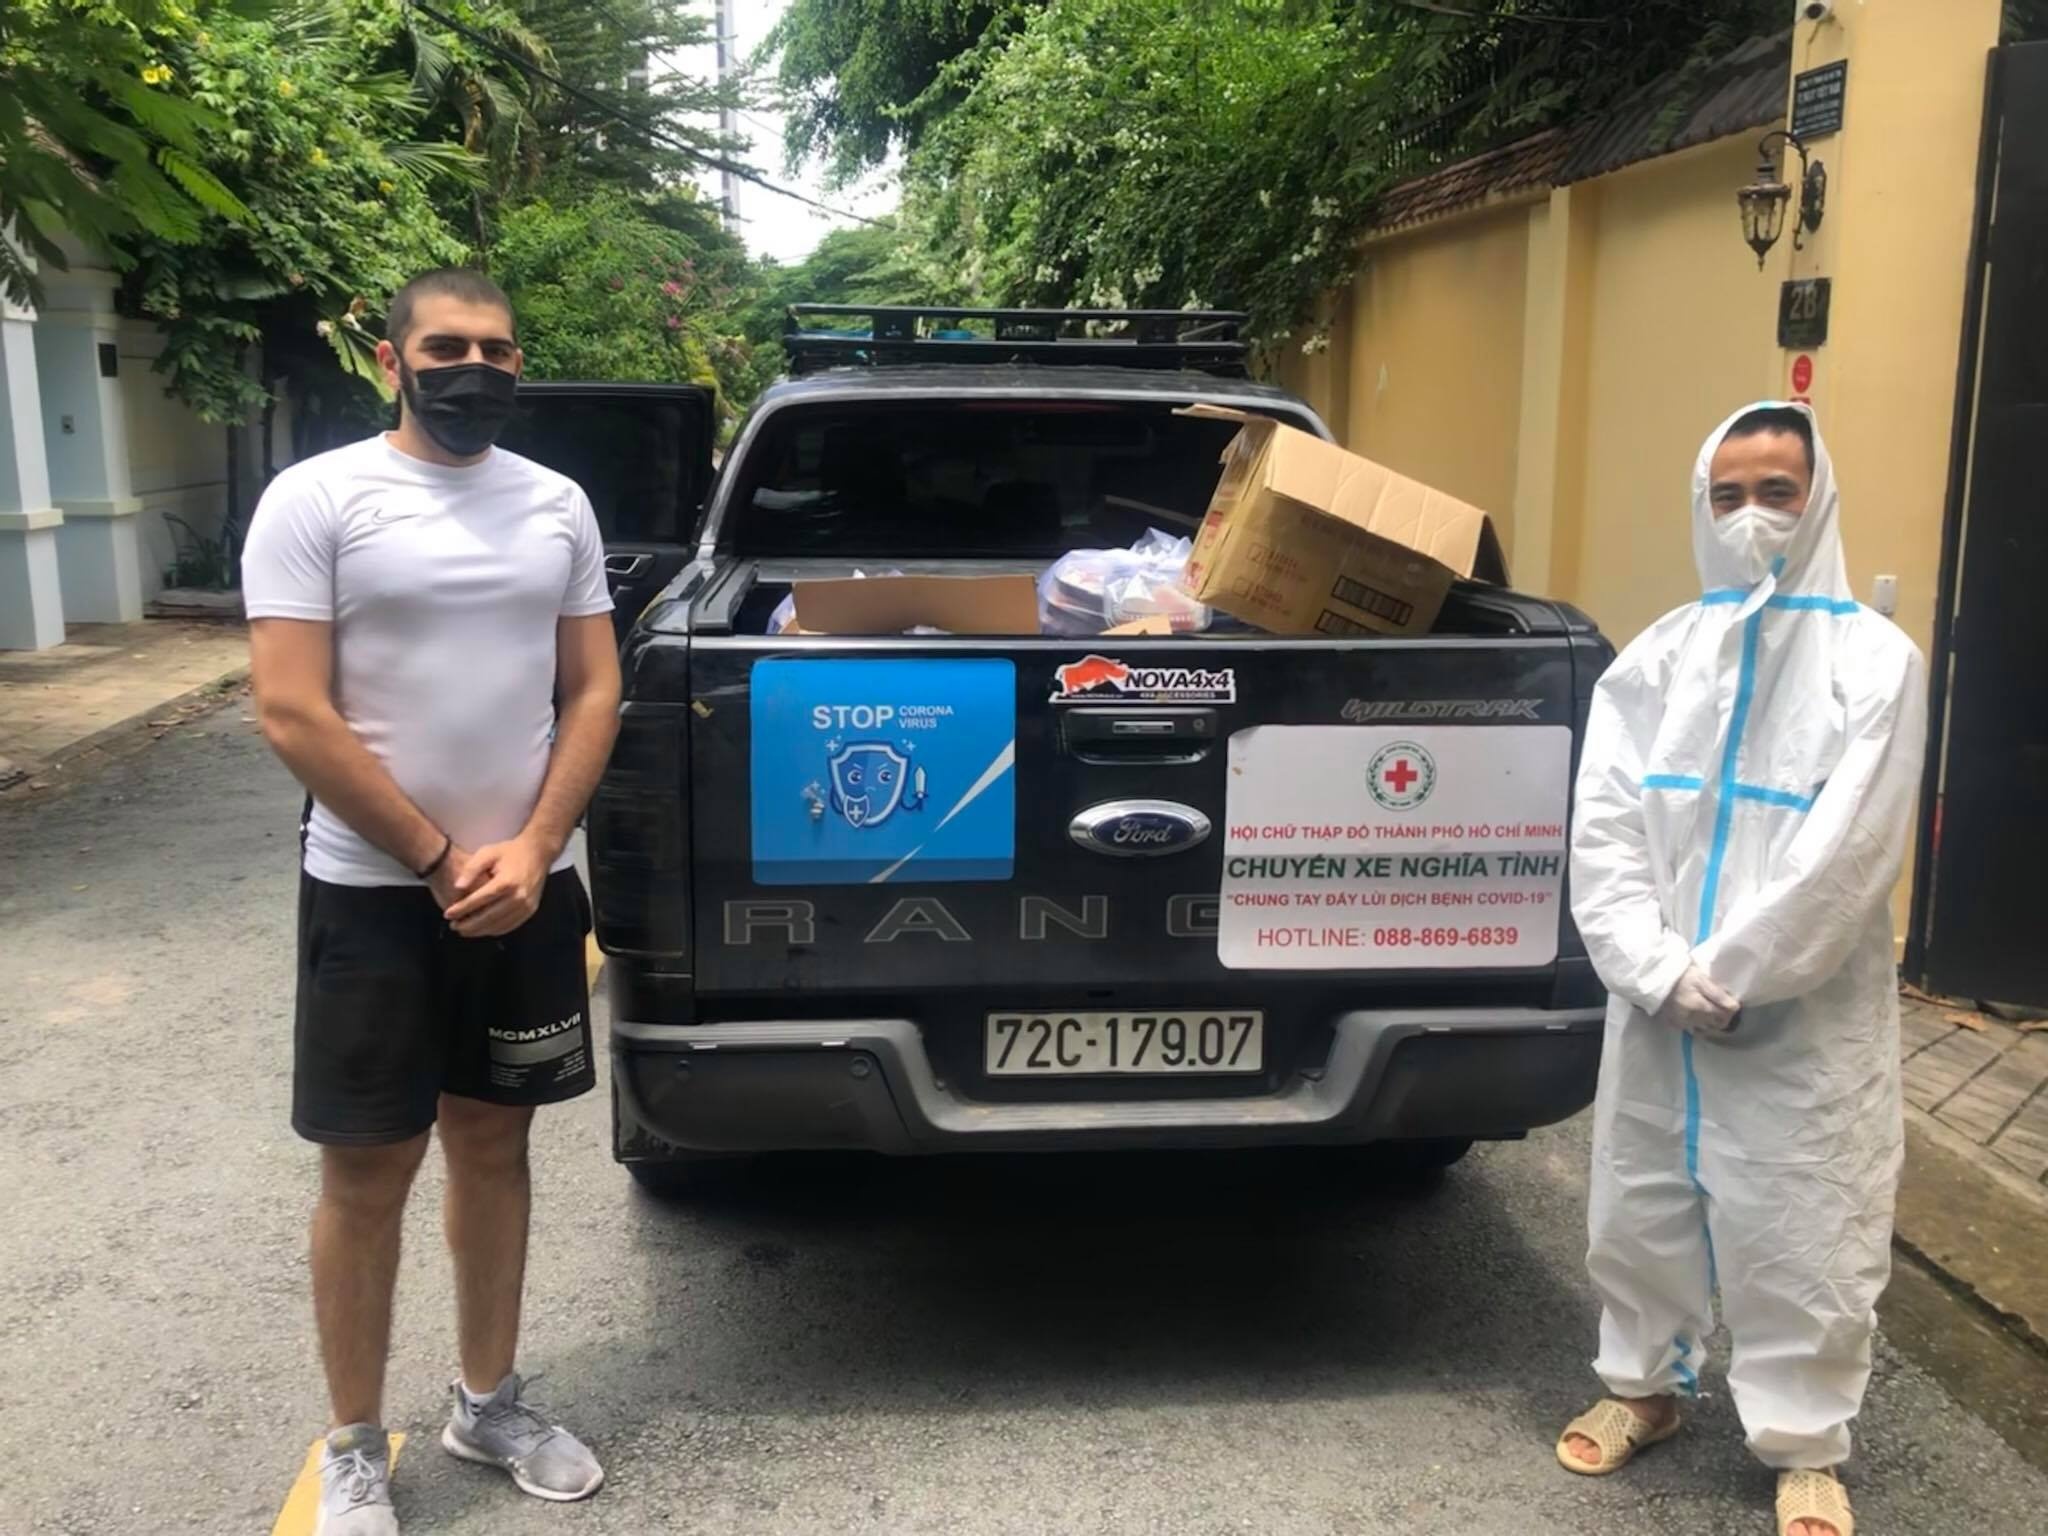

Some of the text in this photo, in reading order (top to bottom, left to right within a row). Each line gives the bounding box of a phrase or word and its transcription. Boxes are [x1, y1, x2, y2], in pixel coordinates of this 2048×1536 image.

[1125, 671, 1229, 689] NOVA4x4
[813, 705, 954, 729] STOP CORONA
[899, 718, 937, 729] VIRUS
[1113, 816, 1172, 842] Ford
[1524, 824, 1562, 837] MINH
[1354, 857, 1392, 878] XE
[1400, 852, 1488, 877] NGHĨA
[1498, 851, 1559, 877] TÌNH
[1295, 893, 1322, 906] TAY
[1258, 926, 1518, 947] HOTLINE: 088-869-6839
[996, 1016, 1254, 1068] 72C-179.07
